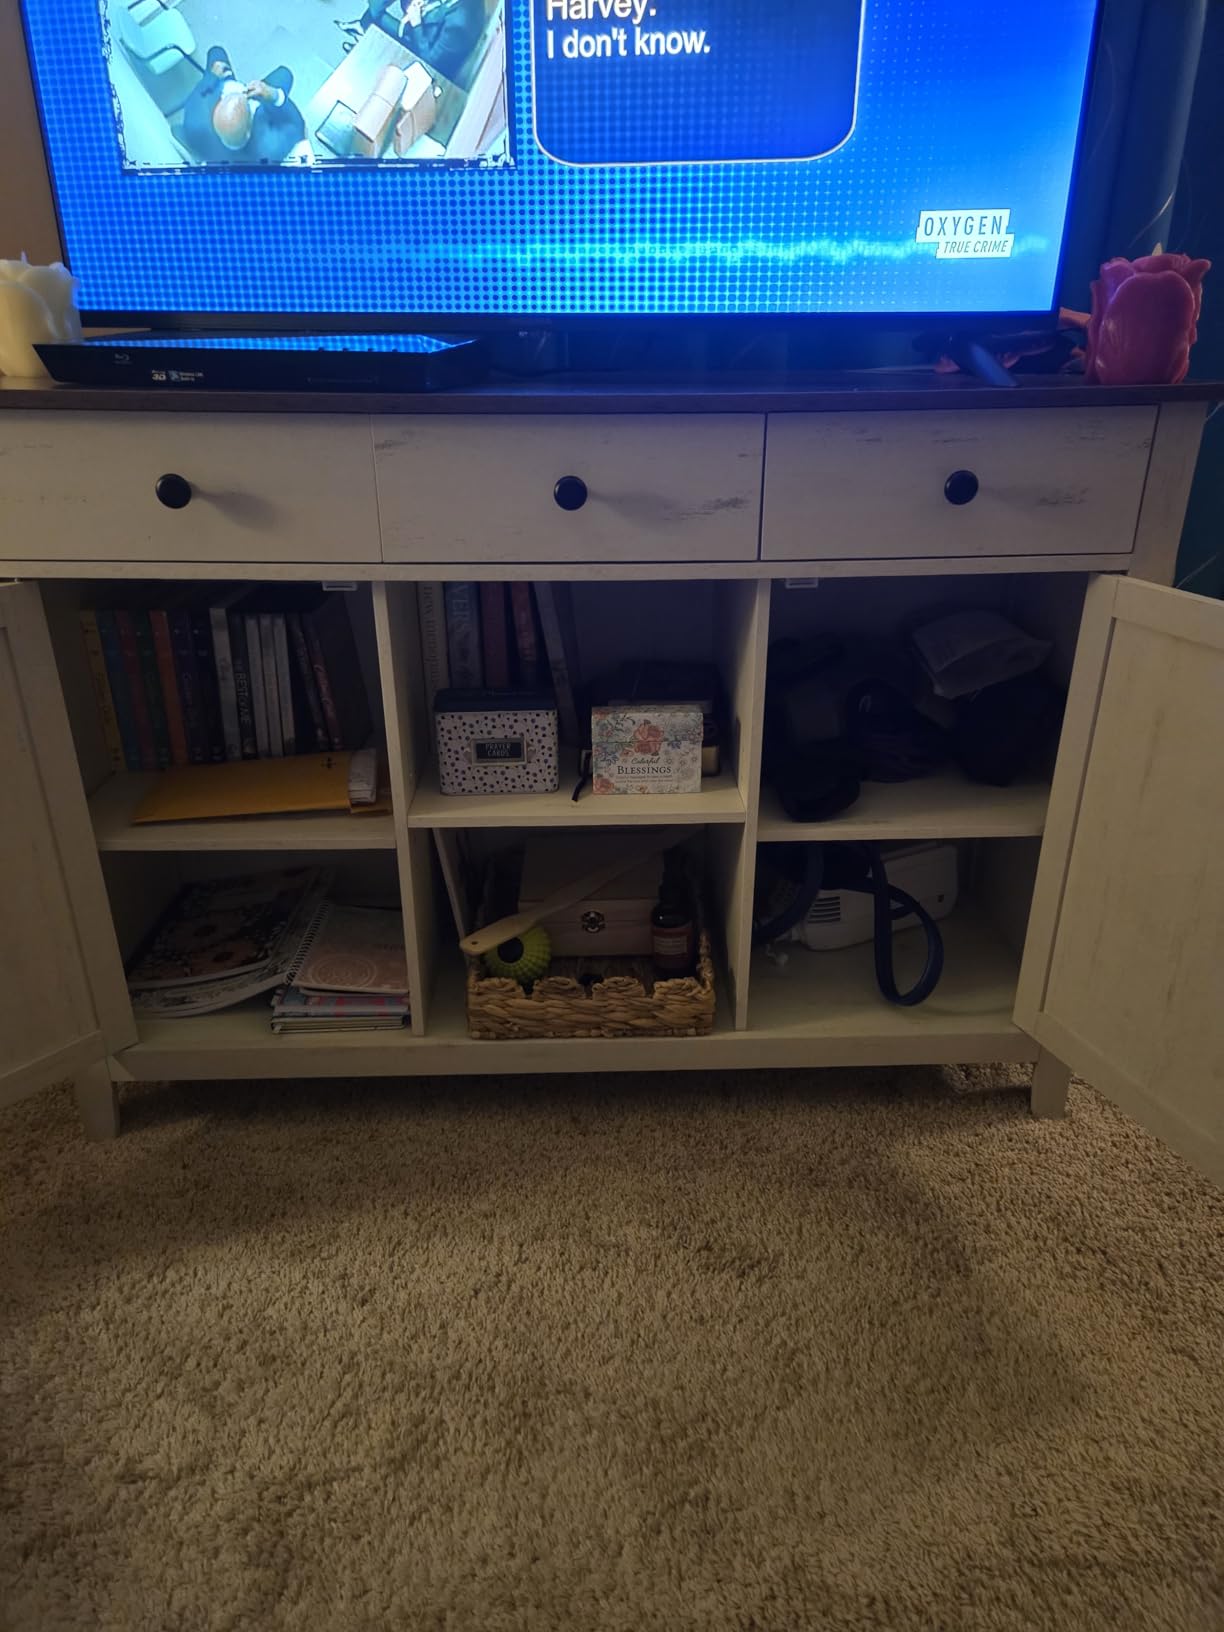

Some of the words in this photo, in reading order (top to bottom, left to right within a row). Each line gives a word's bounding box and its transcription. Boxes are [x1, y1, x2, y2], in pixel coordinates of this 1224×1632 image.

[547, 0, 656, 24] Harvey.
[547, 29, 555, 58] I
[562, 27, 627, 58] don't
[634, 26, 711, 56] know.
[924, 215, 1003, 236] OXYGEN
[943, 241, 972, 253] TRUE
[973, 240, 1009, 253] CRIME
